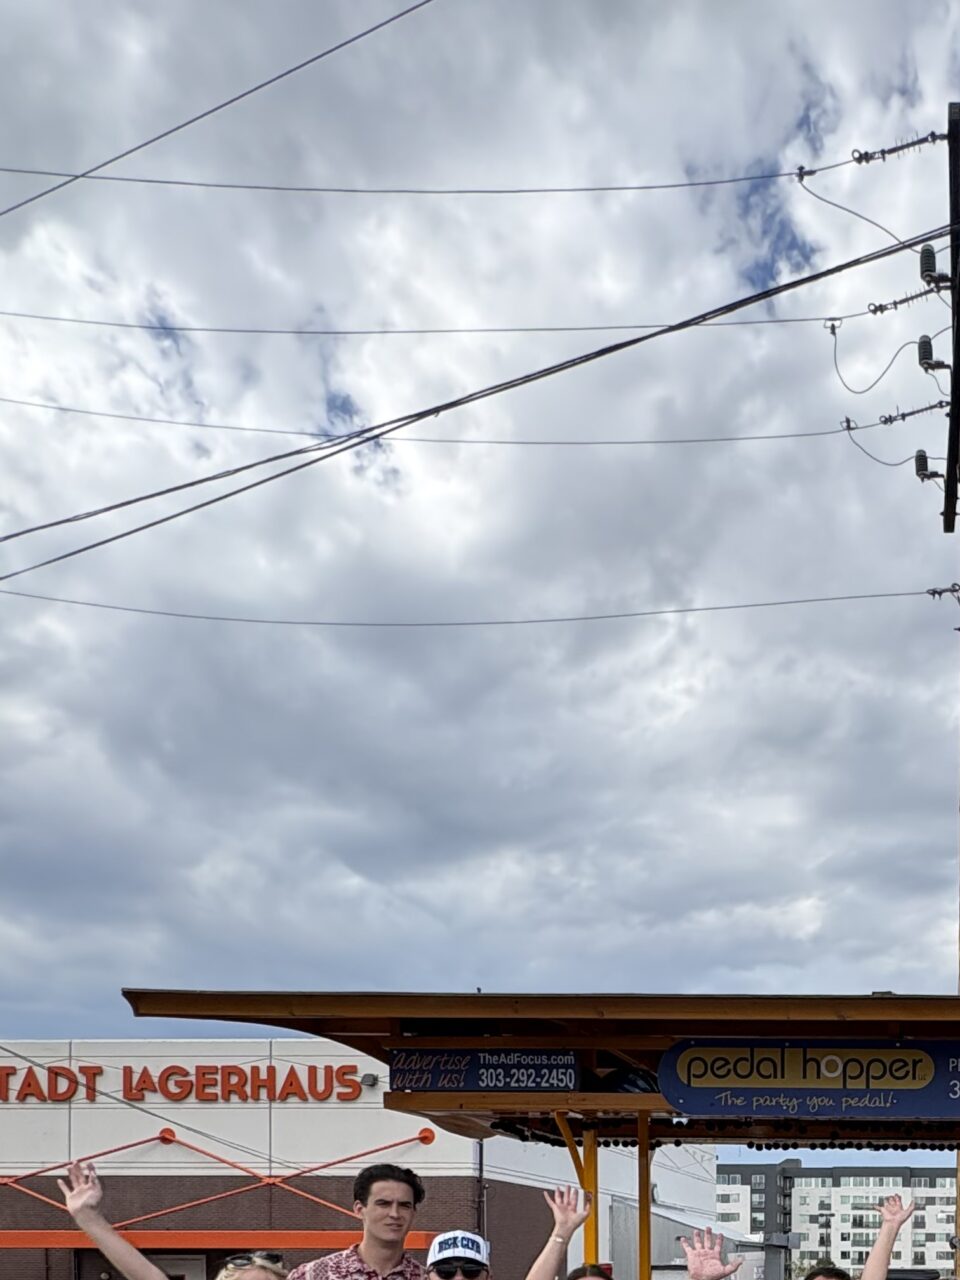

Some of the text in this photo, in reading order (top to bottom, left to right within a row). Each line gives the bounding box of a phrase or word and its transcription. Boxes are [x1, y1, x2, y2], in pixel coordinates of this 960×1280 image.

[478, 1053, 575, 1065] TheAdFocus.com
[687, 1047, 786, 1087] pedal
[802, 1047, 923, 1089] hopper
[122, 1064, 363, 1103] LAGERHAUS
[393, 1071, 432, 1088] with
[478, 1068, 576, 1088] 303-292-2450
[714, 1090, 894, 1114] The party you pedal!
